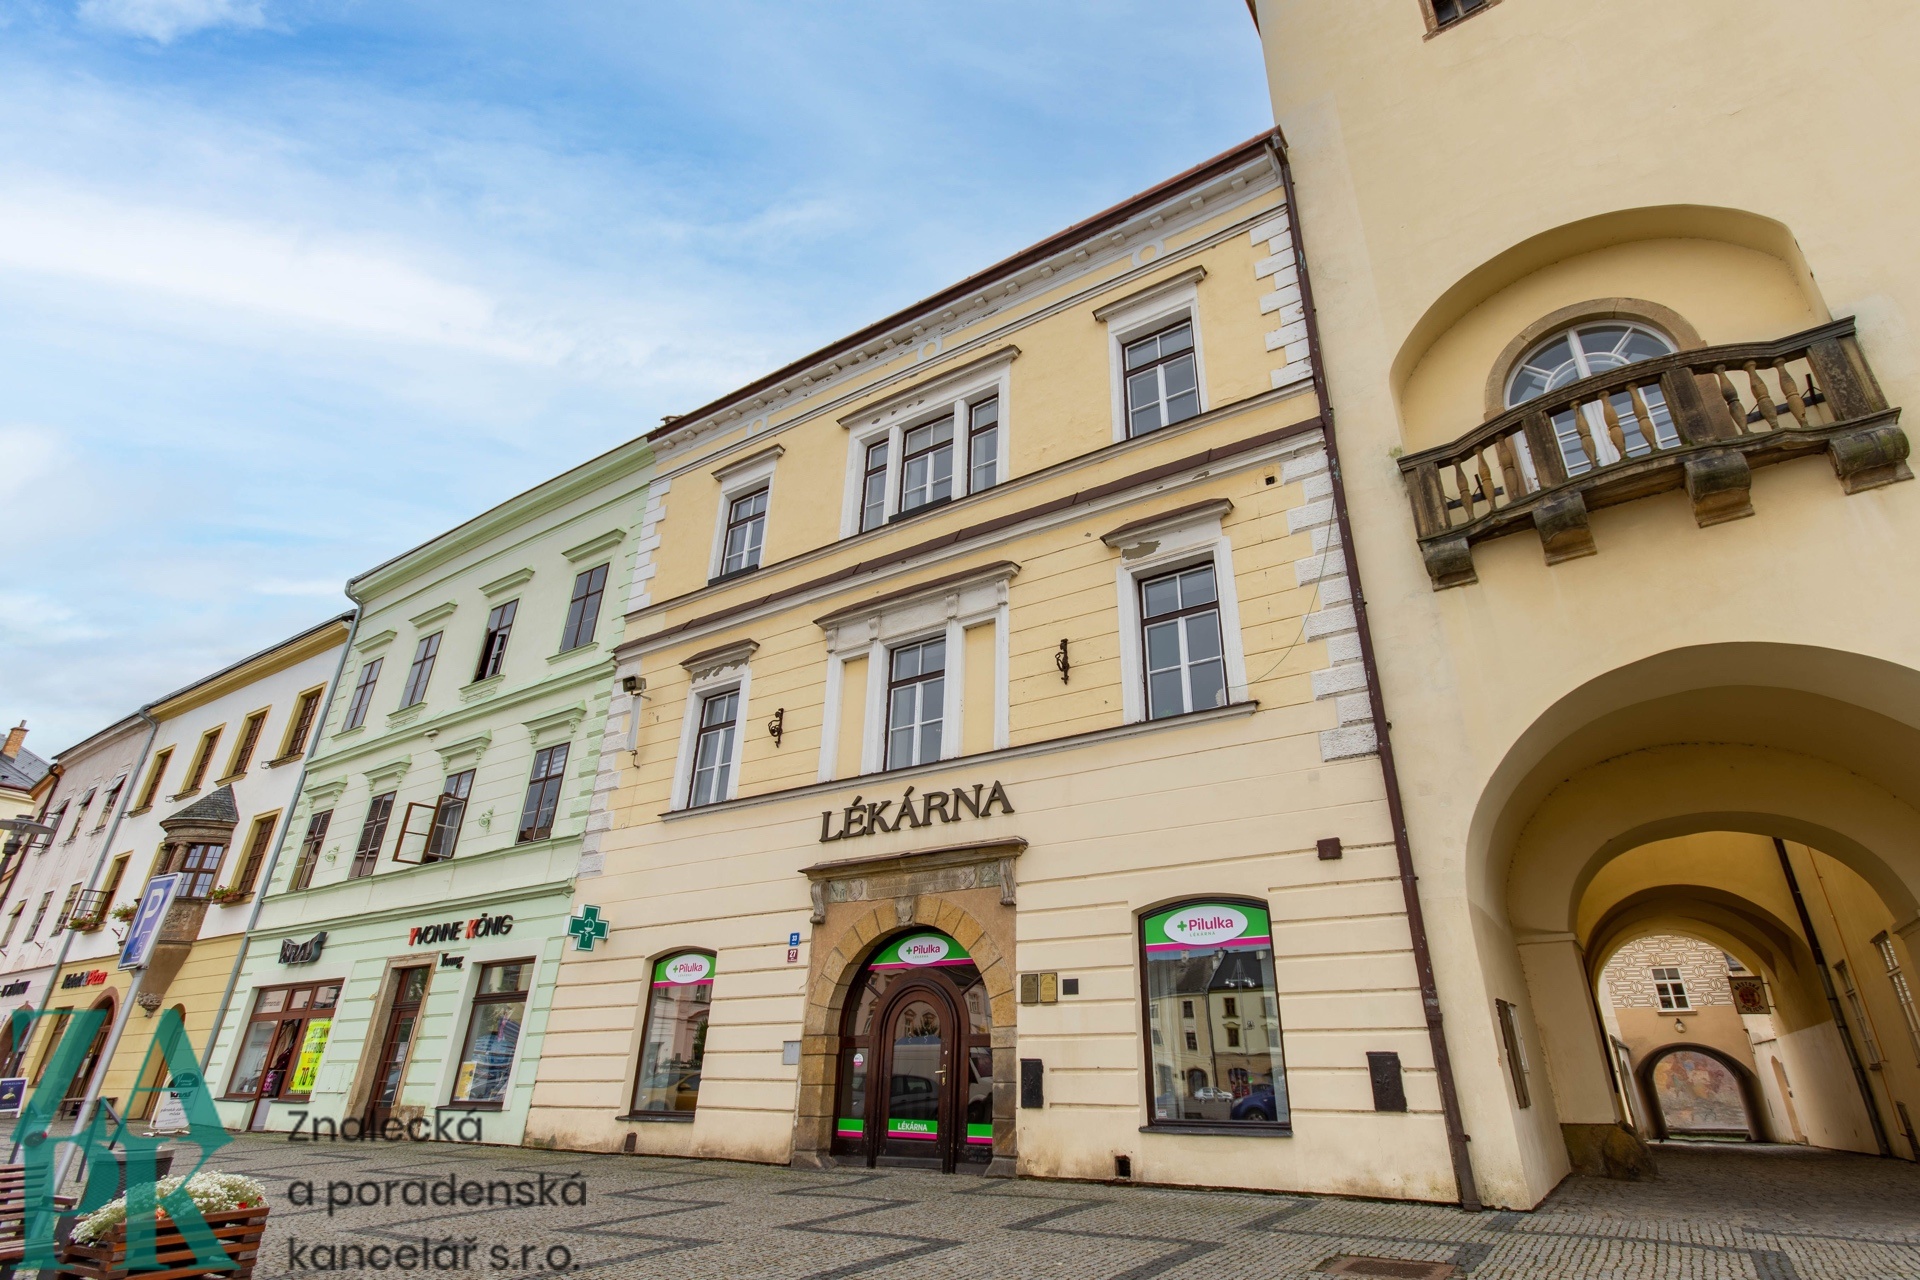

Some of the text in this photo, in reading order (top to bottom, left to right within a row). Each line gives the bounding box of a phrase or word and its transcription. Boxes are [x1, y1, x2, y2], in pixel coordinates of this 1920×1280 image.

[819, 780, 1015, 842] LÉKÁRNA
[135, 888, 164, 937] P
[408, 913, 514, 946] YVONNE KÖNIG
[1189, 917, 1234, 932] Pilulka
[790, 950, 797, 958] 27
[912, 944, 941, 955] Pilulka
[679, 962, 703, 973] Pilulka
[897, 1120, 928, 1132] LÉKÁRNA
